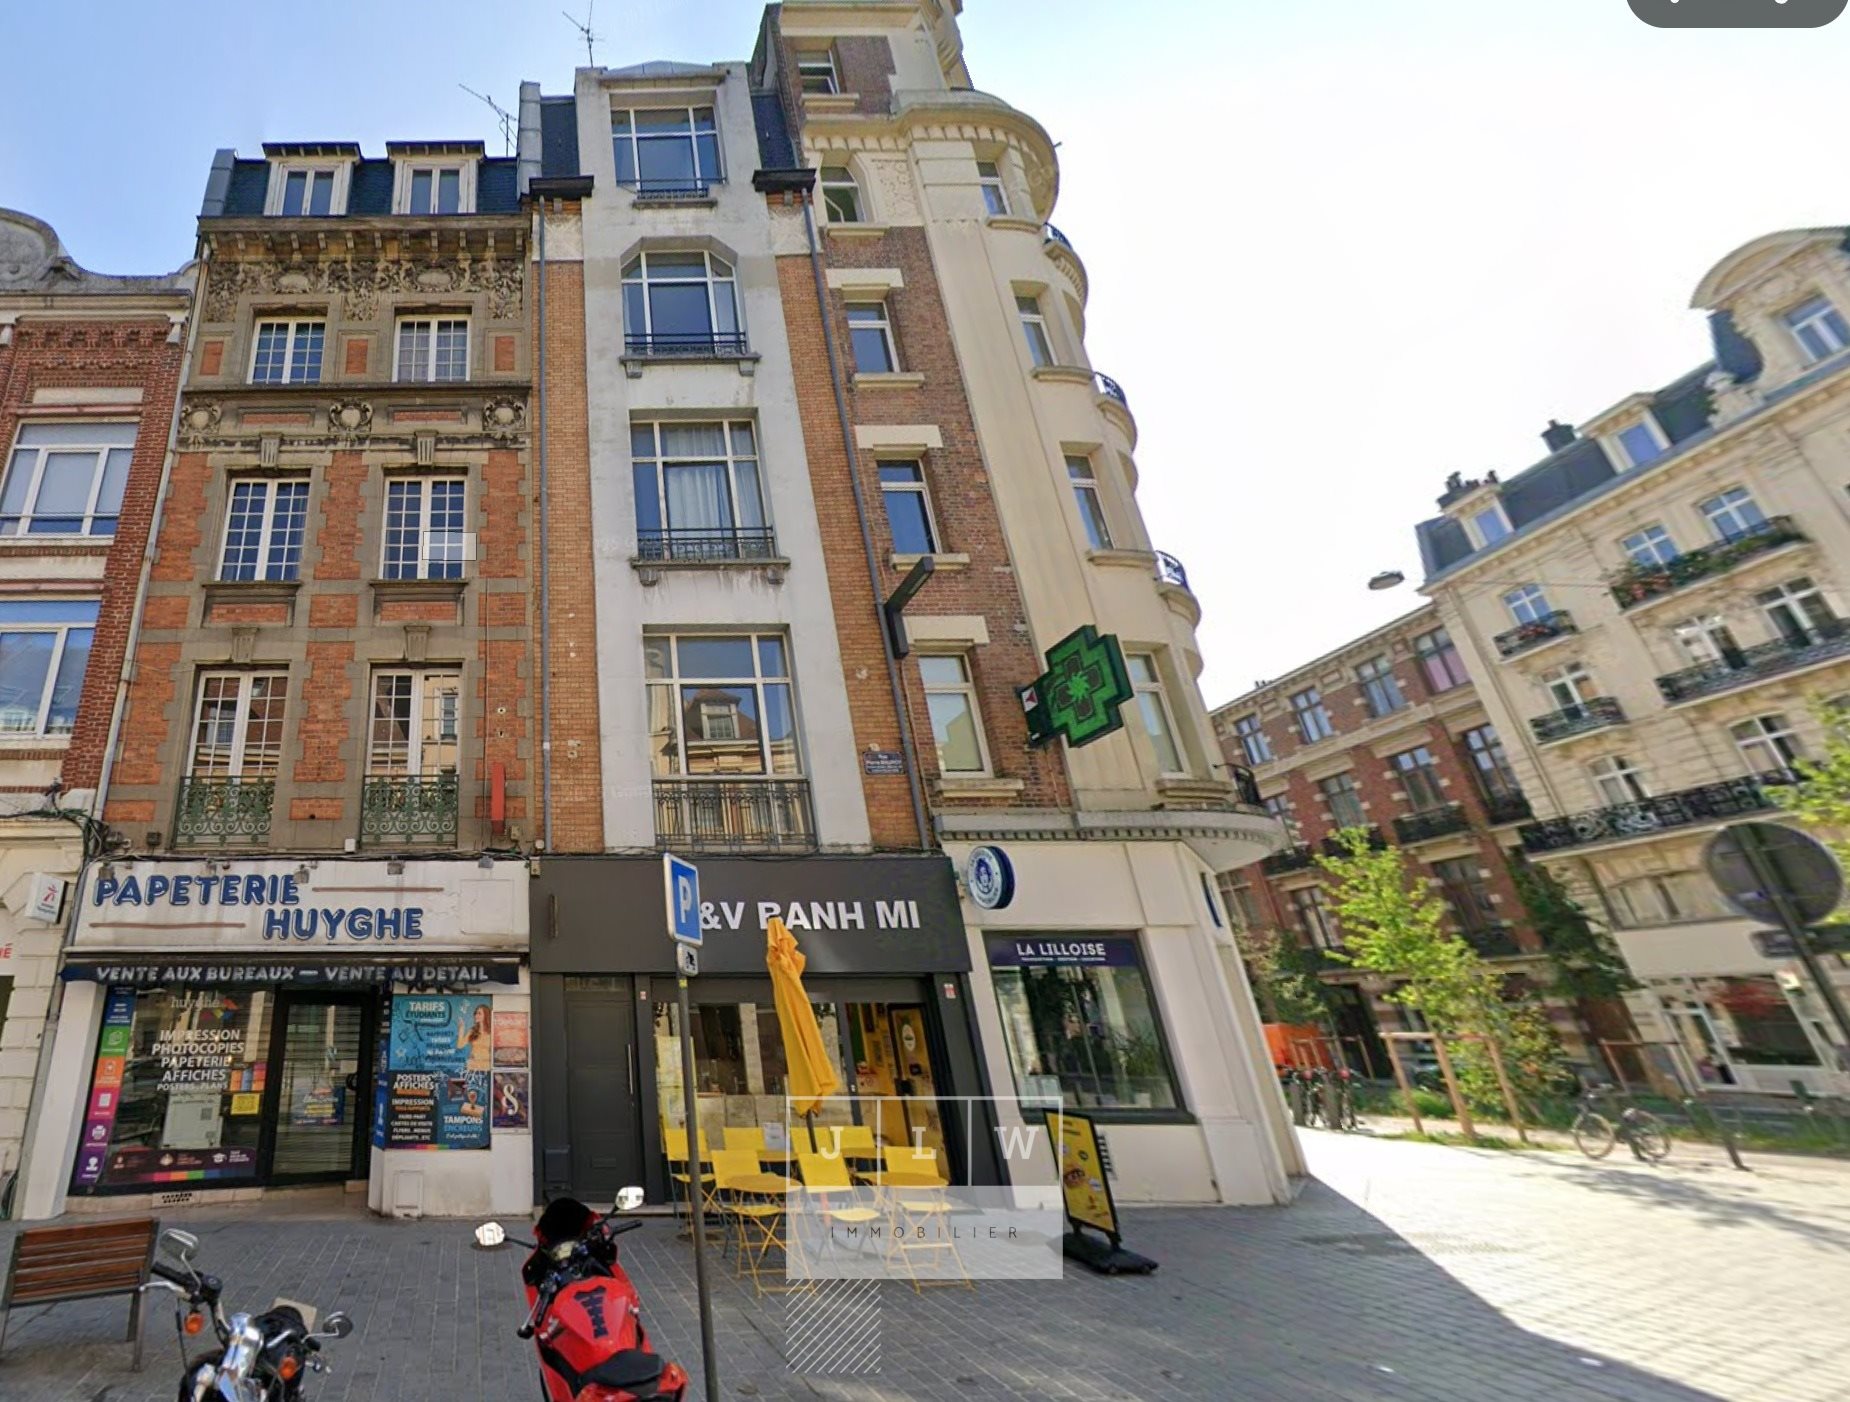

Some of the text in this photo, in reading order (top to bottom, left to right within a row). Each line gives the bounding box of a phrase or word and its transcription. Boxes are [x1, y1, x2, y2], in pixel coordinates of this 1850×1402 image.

[93, 874, 299, 907] PAPETERIE
[678, 874, 692, 924] P
[875, 900, 921, 929] MI
[262, 907, 424, 941] HUYGHE
[1016, 943, 1107, 956] LA LILLOISE
[96, 966, 158, 981] VENTE
[161, 966, 203, 981] AUX
[206, 966, 295, 981] BUREAUX
[324, 965, 386, 981] VENTE
[391, 965, 417, 981] AU
[422, 965, 489, 981] DETAIL
[409, 1001, 446, 1011] TARIFS
[160, 1029, 241, 1041] IMPRESSION
[151, 1042, 245, 1055] PHOTOCOPIES
[161, 1055, 231, 1068] PAPETERIE
[162, 1069, 227, 1082] AFFICHES
[396, 1073, 432, 1082] POSTERS
[393, 1081, 435, 1090] AFFICHES
[391, 1098, 434, 1106] IMPRESSION
